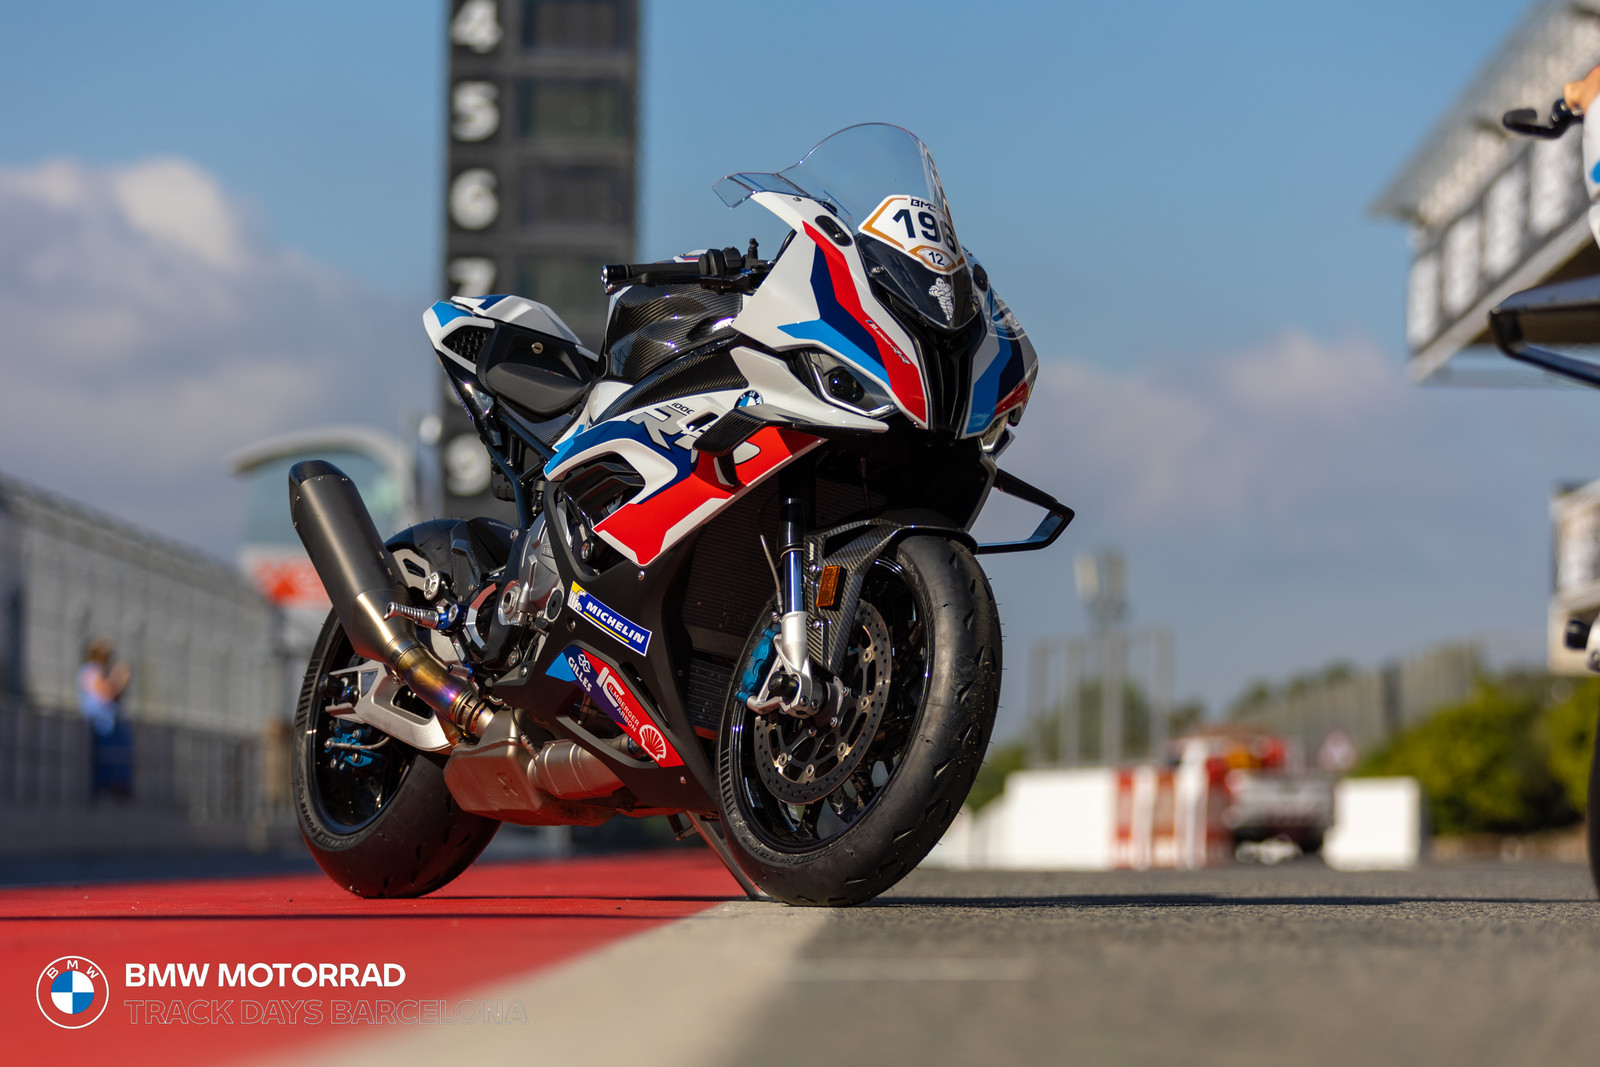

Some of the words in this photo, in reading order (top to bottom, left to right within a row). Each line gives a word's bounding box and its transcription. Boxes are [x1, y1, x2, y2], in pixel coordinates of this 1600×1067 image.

[449, 80, 499, 143] 5
[448, 167, 499, 231] 6
[910, 198, 937, 213] BMC
[928, 251, 945, 266] 12
[585, 601, 646, 644] MICHELIN
[567, 656, 593, 693] GILLES
